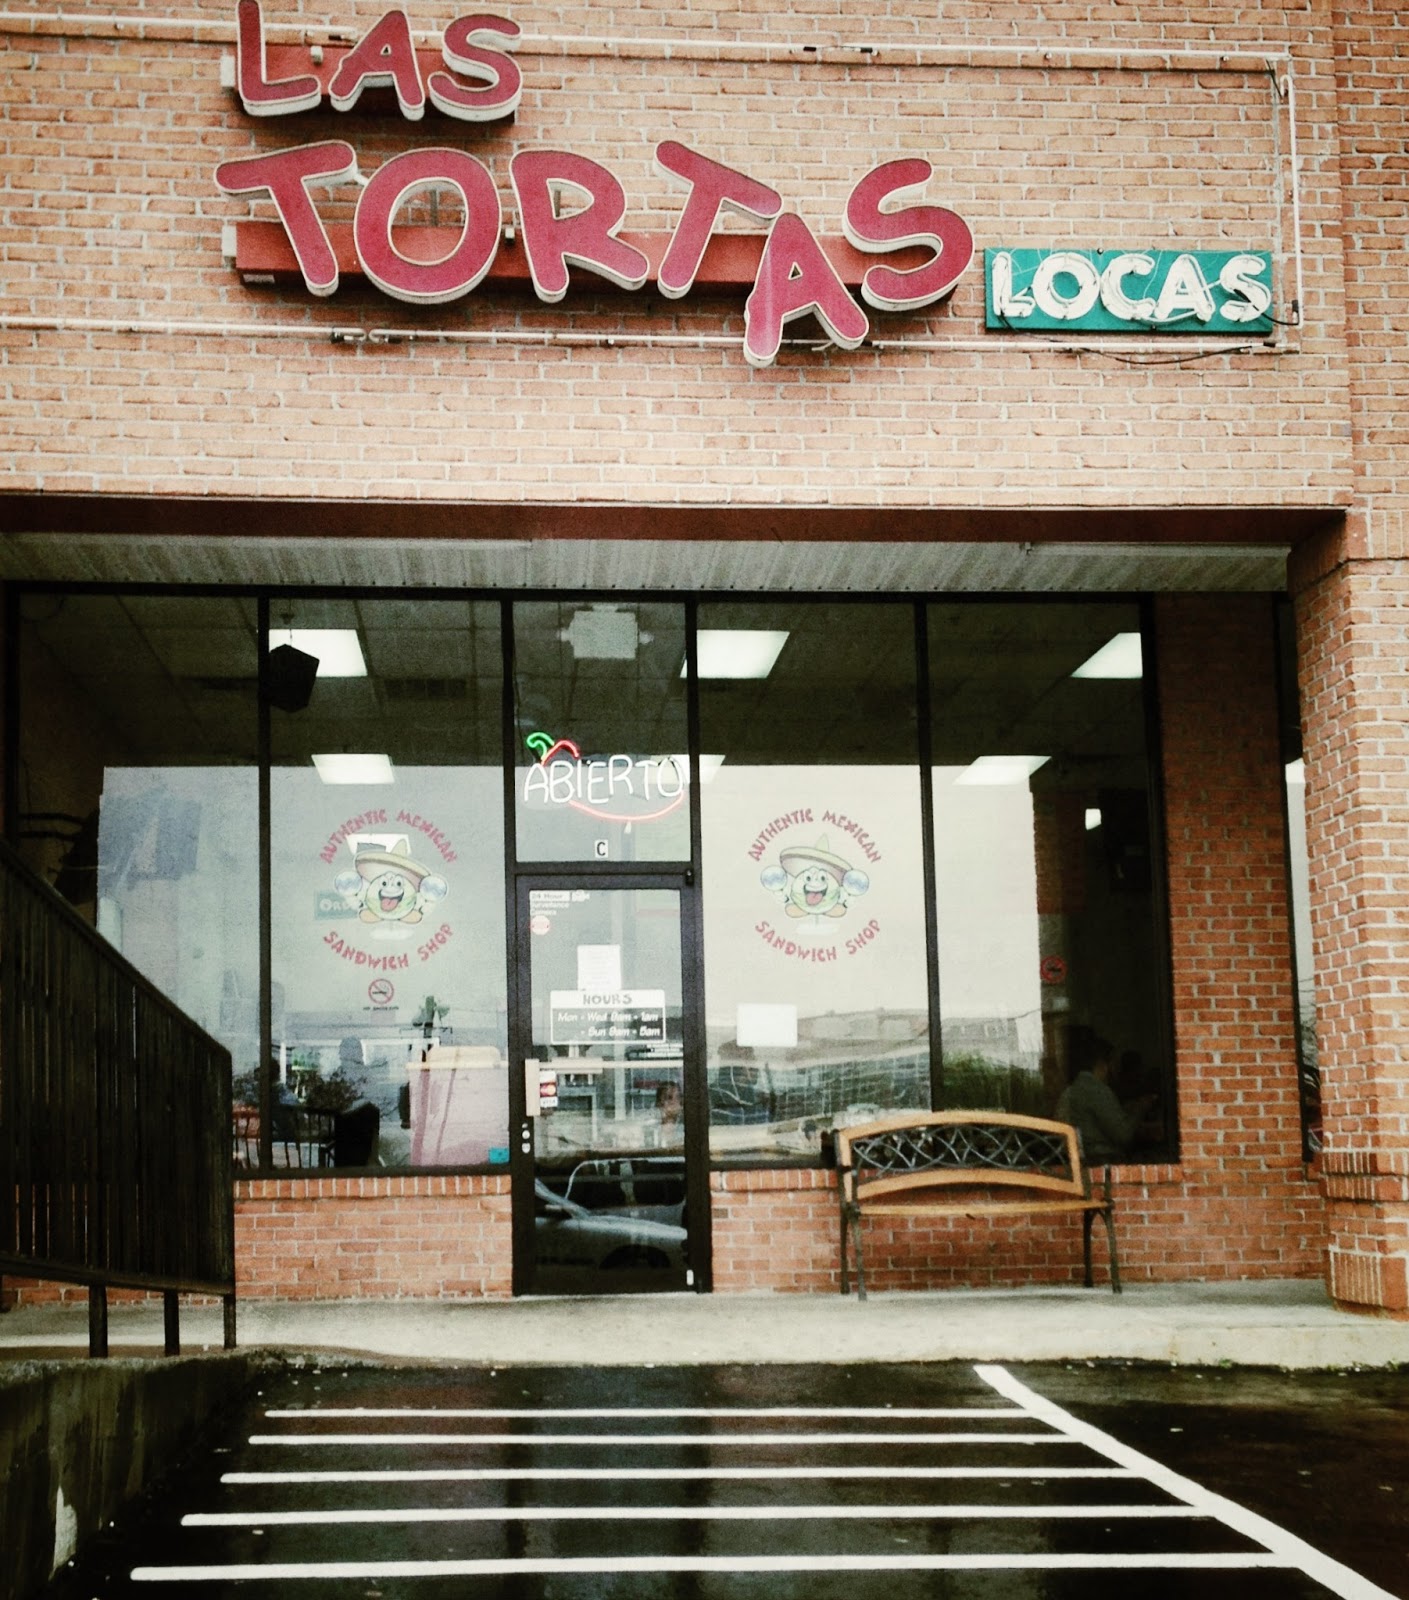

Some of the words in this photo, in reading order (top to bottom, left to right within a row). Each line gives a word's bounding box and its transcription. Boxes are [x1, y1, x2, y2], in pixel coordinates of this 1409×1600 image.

[237, 0, 522, 120] LAS
[213, 140, 976, 367] TORTAS
[992, 250, 1271, 322] LOCAS
[524, 754, 684, 804] ABIERTO
[319, 809, 387, 864] AUTHENTIC
[396, 810, 458, 863] MEXICAN
[596, 841, 607, 856] C
[748, 808, 814, 862] AUTHENTIC
[822, 810, 882, 863] MEXICAN
[323, 931, 409, 971] SANDWICH
[417, 923, 454, 961] SHOP
[755, 921, 837, 962] SANDWICH
[845, 919, 881, 955] SHOP
[558, 1012, 578, 1021] Mon
[582, 994, 633, 1005] HOURS
